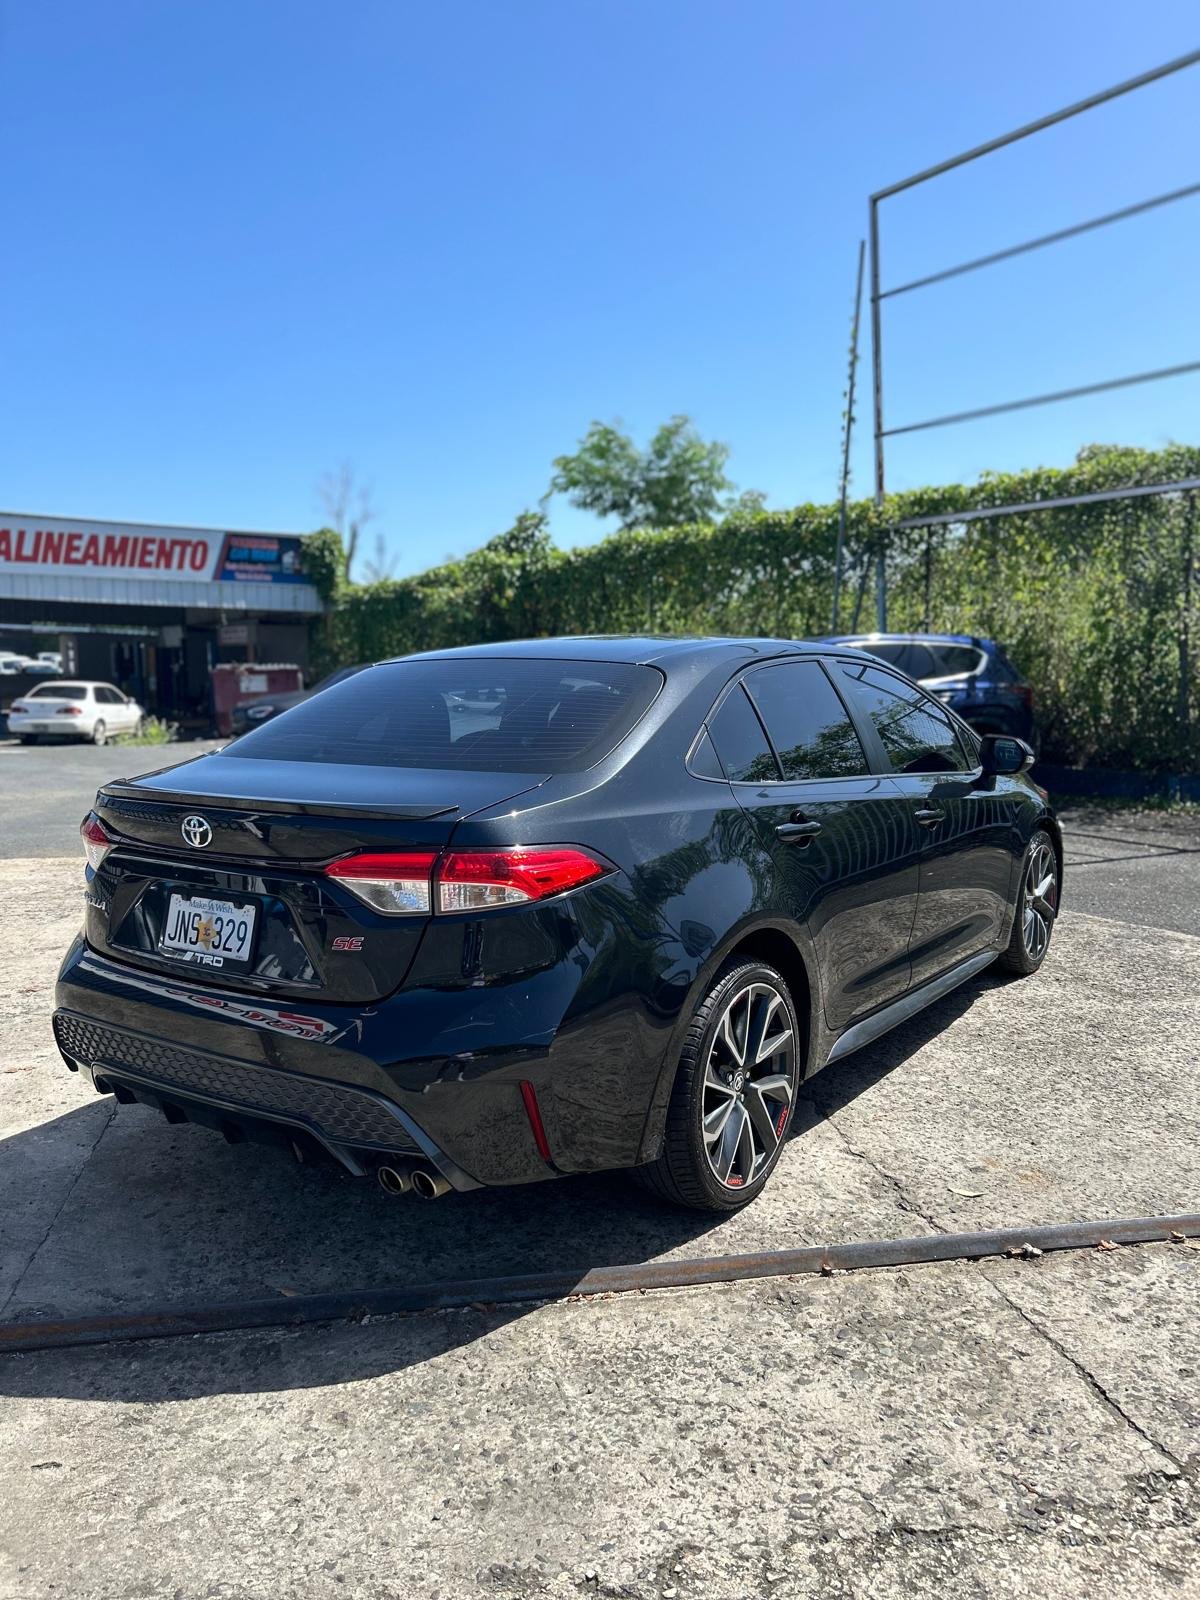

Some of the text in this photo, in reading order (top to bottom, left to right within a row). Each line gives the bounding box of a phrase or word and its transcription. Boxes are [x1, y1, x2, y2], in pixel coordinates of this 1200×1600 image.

[0, 528, 209, 572] ALINEAMIENTO
[331, 936, 365, 951] SE
[194, 952, 224, 968] TRD
